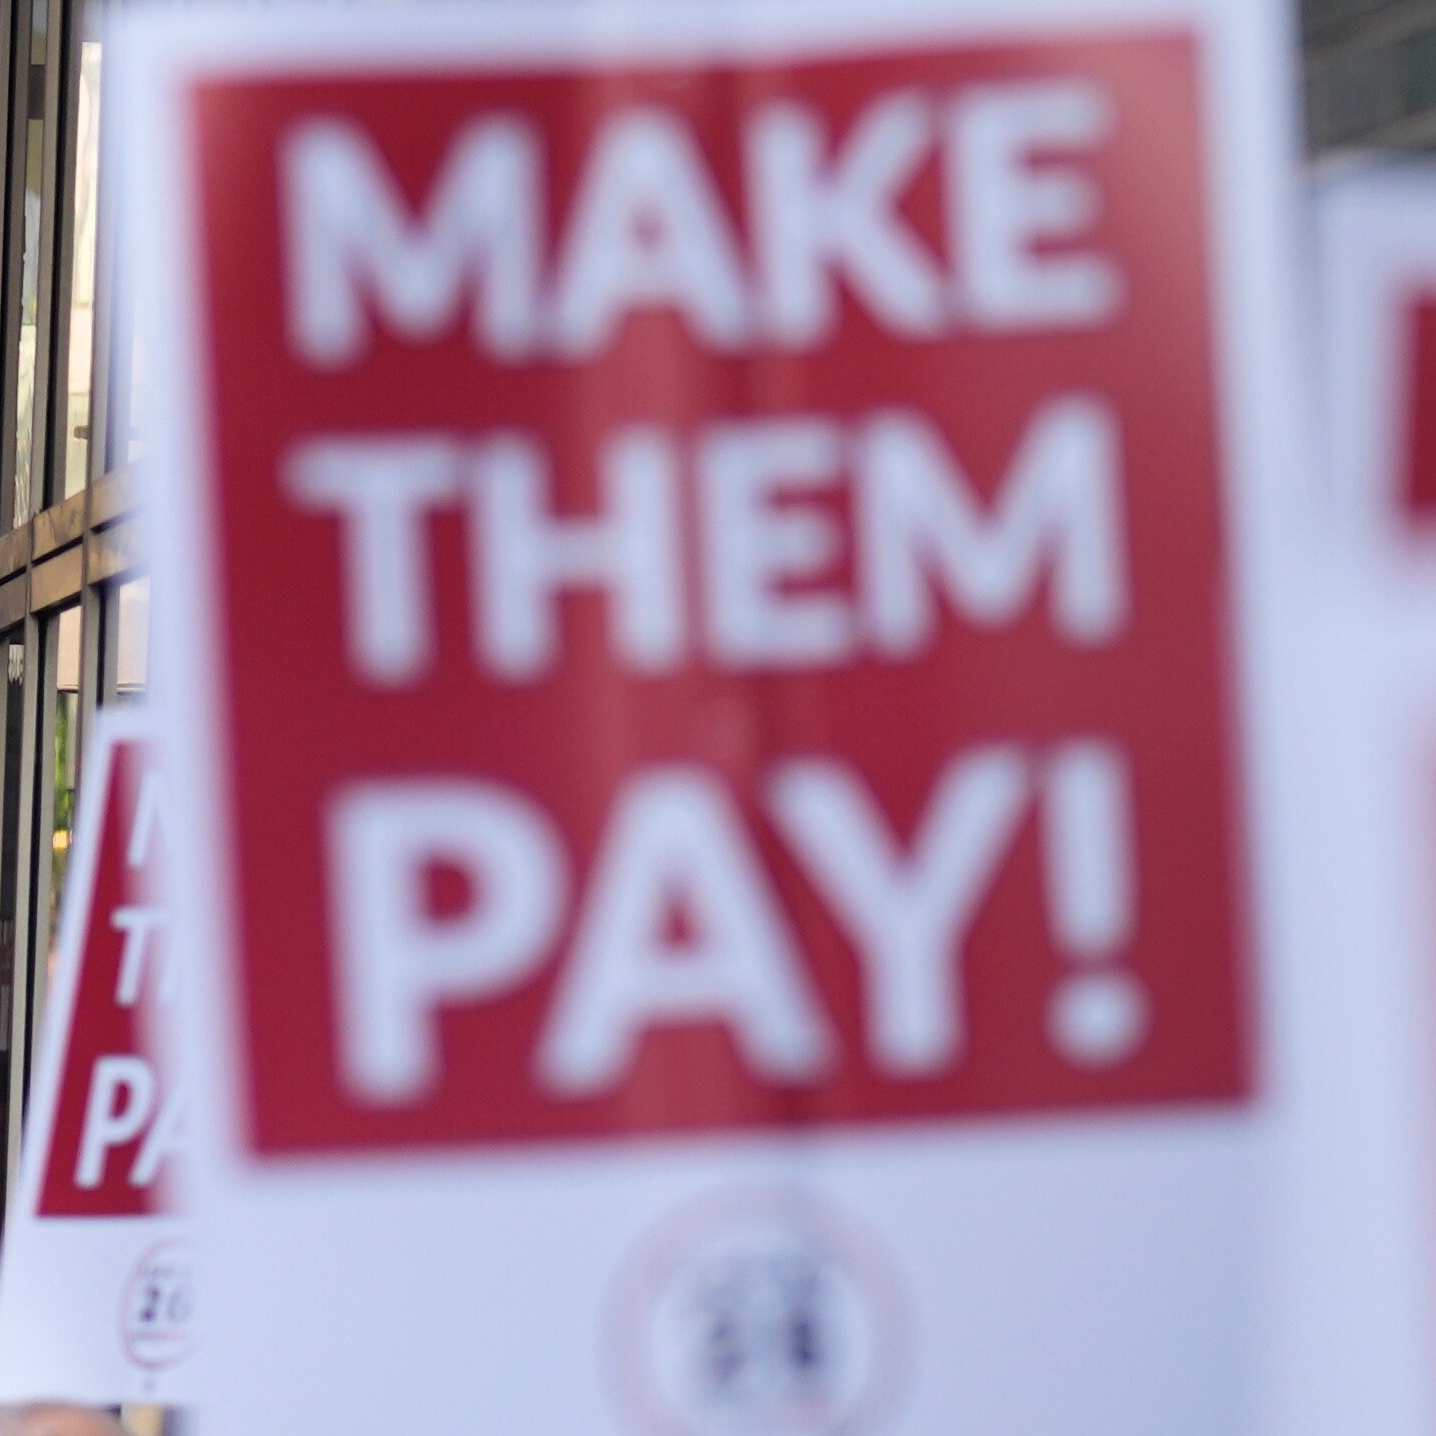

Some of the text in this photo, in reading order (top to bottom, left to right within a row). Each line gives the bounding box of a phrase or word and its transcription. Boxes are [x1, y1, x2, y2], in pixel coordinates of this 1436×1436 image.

[278, 78, 1120, 369] MAKE
[281, 396, 1121, 688] THEM
[329, 736, 1150, 1110] PAY!
